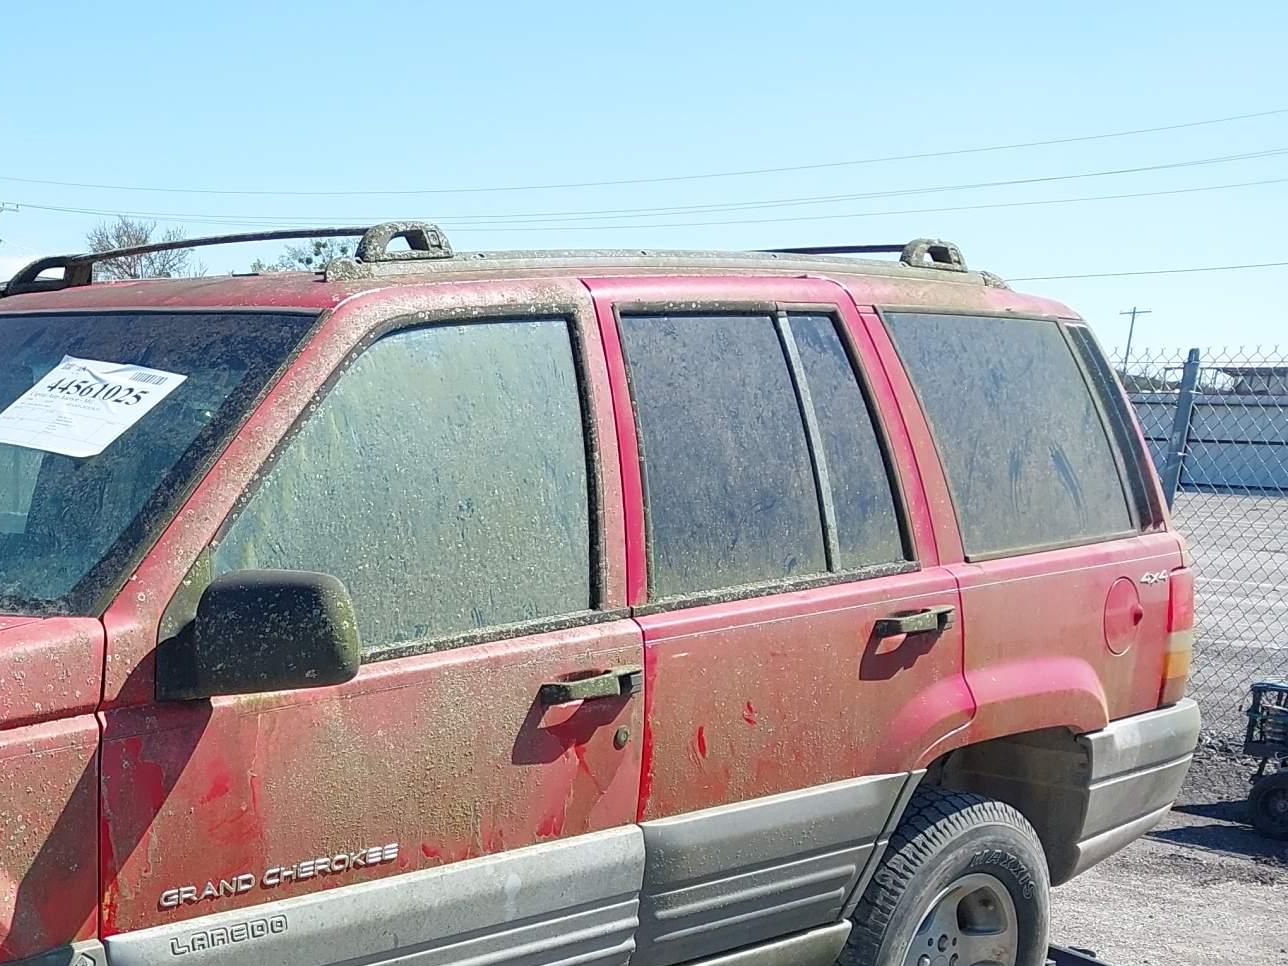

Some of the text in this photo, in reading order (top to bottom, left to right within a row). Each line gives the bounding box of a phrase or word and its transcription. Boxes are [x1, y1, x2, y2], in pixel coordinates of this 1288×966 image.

[47, 377, 150, 406] 44561025
[159, 843, 400, 910] GRAND CHEROKEE
[970, 848, 1036, 900] MAXXIS
[170, 914, 288, 956] LAREDO
